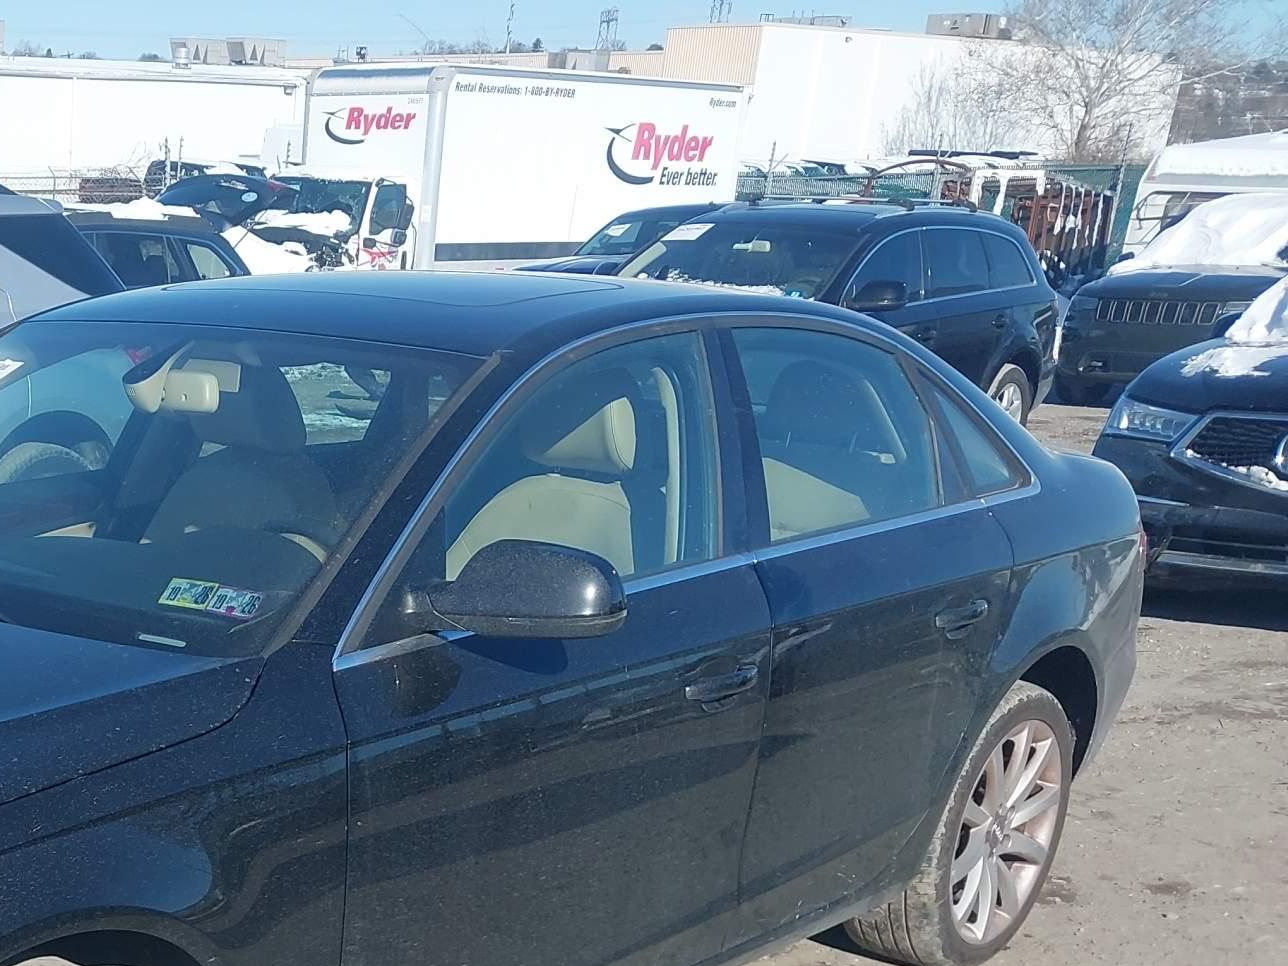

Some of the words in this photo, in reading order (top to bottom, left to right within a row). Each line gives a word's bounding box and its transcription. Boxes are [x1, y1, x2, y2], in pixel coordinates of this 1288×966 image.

[455, 82, 477, 93] Rental
[478, 83, 522, 96] Reservations:
[524, 86, 576, 99] 1-800-BY-RYDER
[709, 97, 737, 109] Ryder.com
[345, 106, 416, 136] Ryder
[631, 122, 714, 171] Ryder
[658, 166, 684, 186] Ever
[684, 168, 718, 187] better.
